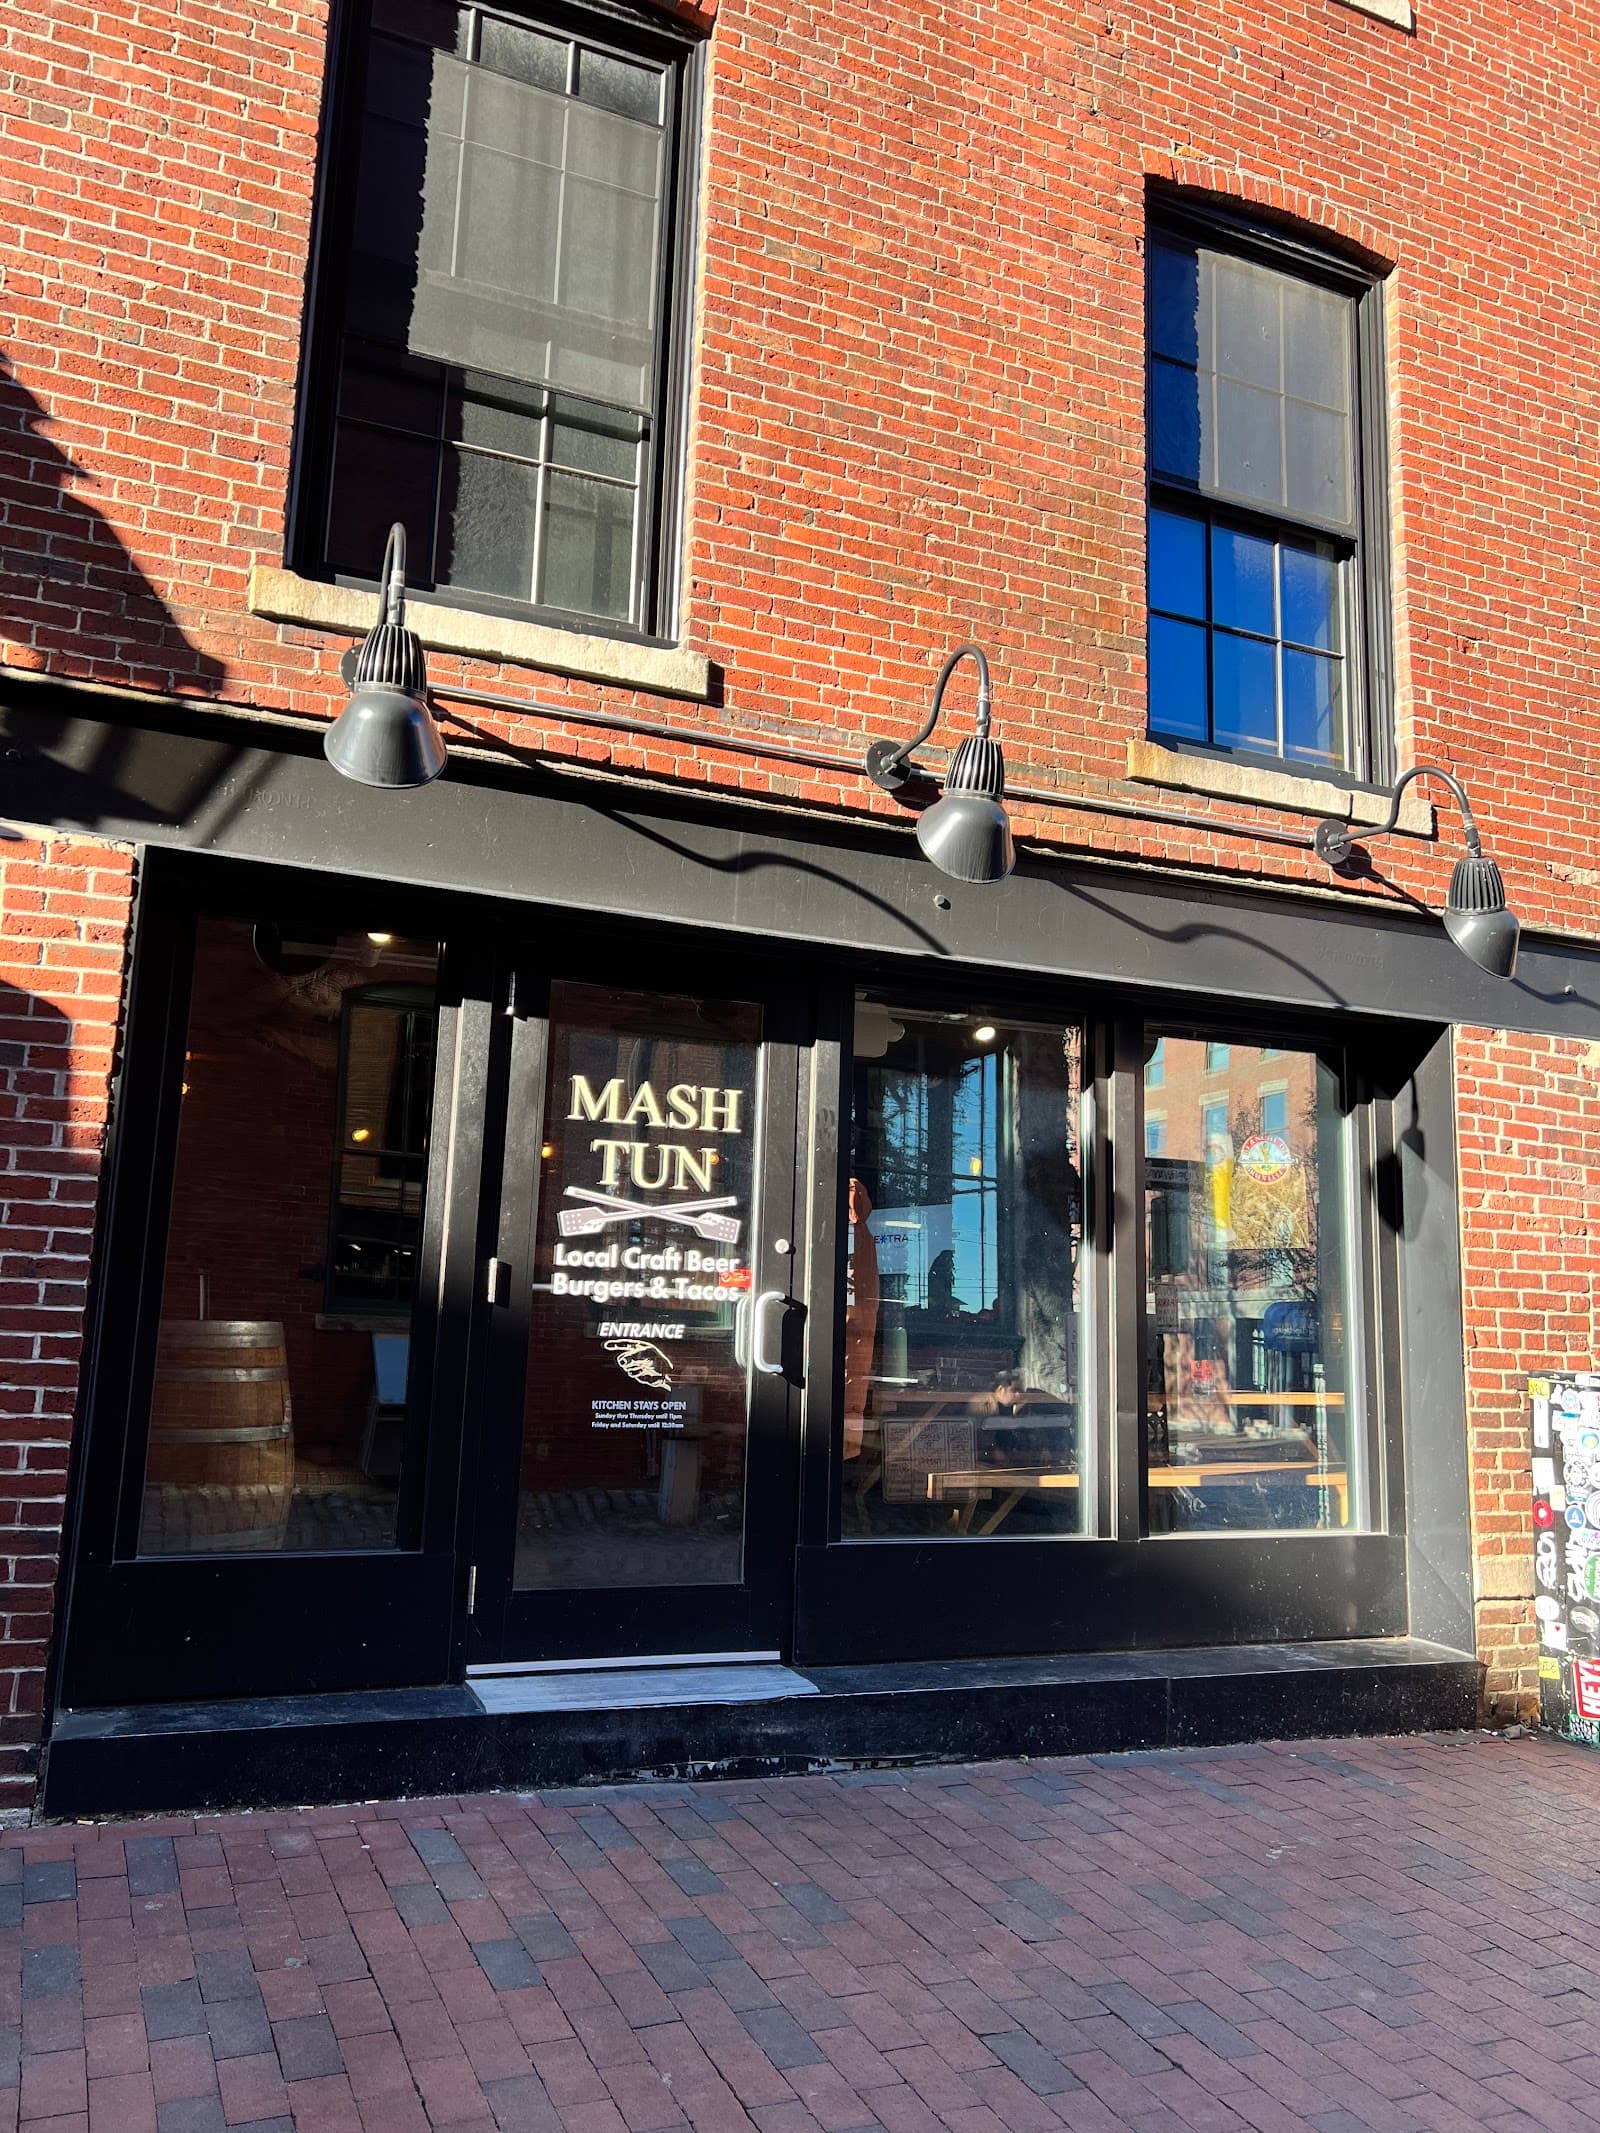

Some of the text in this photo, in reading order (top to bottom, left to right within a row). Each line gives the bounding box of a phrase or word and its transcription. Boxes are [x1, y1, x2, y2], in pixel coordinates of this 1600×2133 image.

[565, 1075, 743, 1133] MASH
[590, 1139, 718, 1192] TUN
[553, 1243, 740, 1272] Local Craft Beer
[550, 1272, 645, 1303] Burgers
[649, 1276, 669, 1299] &
[672, 1277, 739, 1301] Tacos
[597, 1322, 685, 1339] ENTRANCE
[591, 1400, 686, 1411] KITCHEN STAYS OPEN
